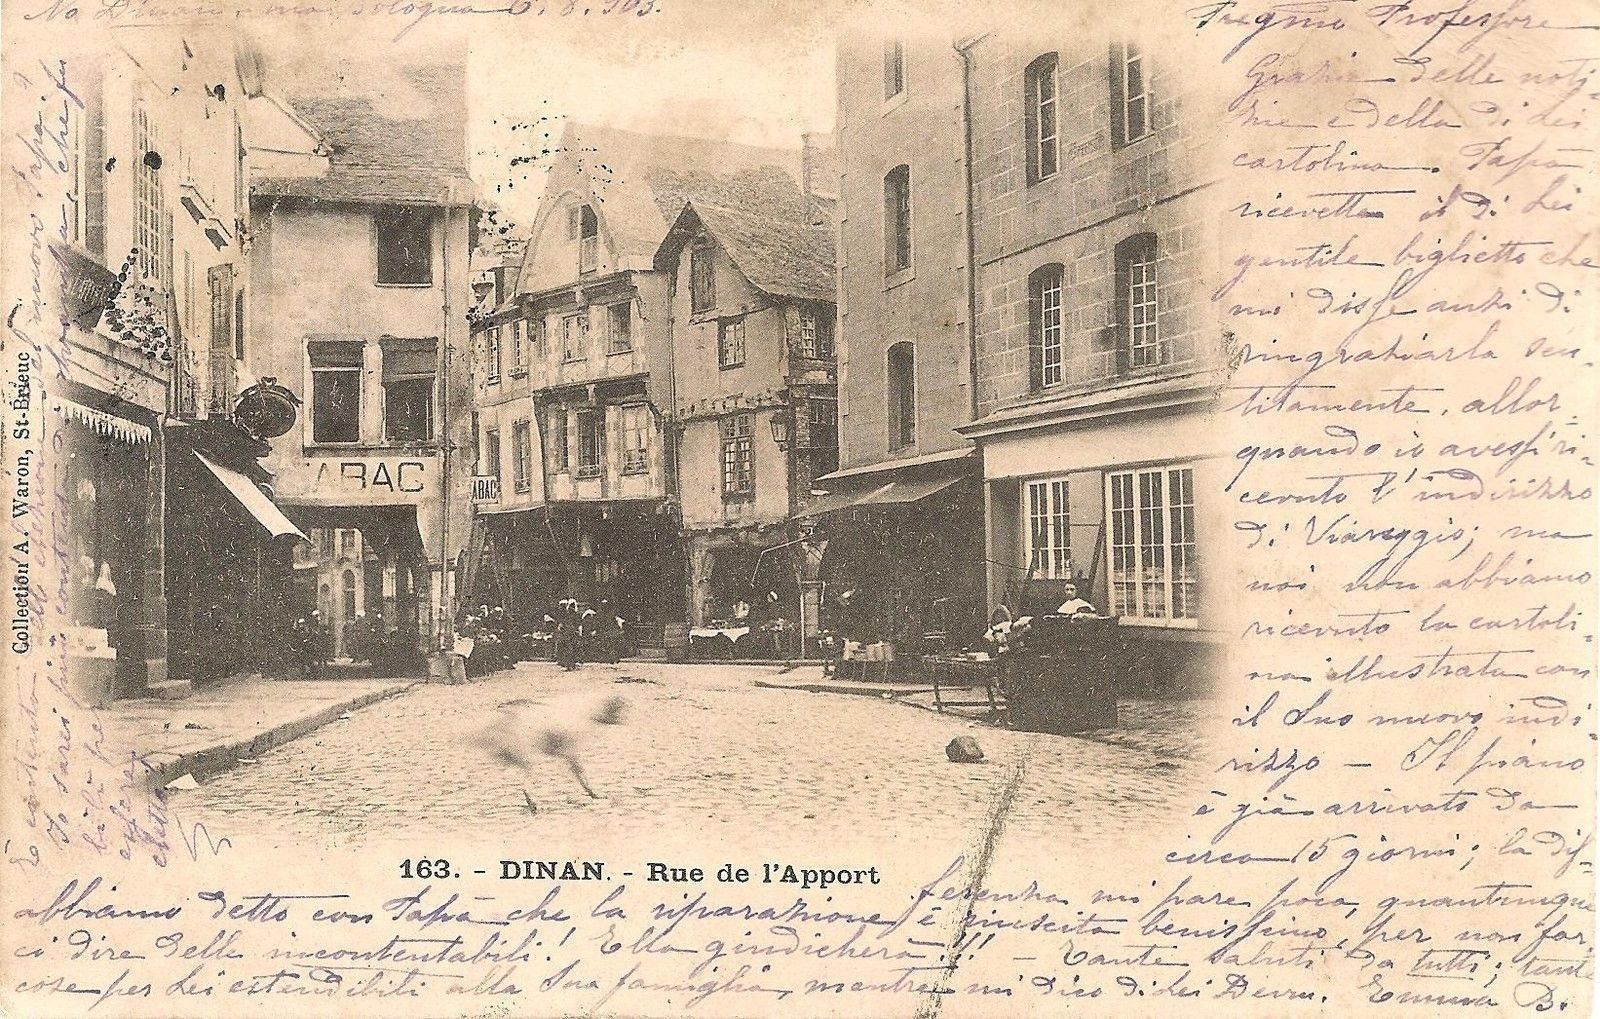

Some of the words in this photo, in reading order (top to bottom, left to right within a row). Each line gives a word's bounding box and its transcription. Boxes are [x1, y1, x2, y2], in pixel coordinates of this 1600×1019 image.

[1393, 55, 1504, 84] delle
[1346, 98, 1461, 129] della
[1521, 184, 1583, 215] Lei
[1211, 234, 1385, 301] gentile
[1393, 230, 1554, 270] biglietto
[1537, 234, 1600, 268] che
[1228, 290, 1294, 316] mi
[1426, 286, 1526, 313] anzi
[1535, 282, 1583, 314] di
[305, 461, 424, 493] ABAC
[1224, 425, 1382, 491] quando
[1234, 520, 1291, 549] di
[1500, 524, 1593, 541] ma
[1248, 564, 1316, 593] noi
[1344, 564, 1419, 592] non
[1433, 552, 1592, 591] abbiamo
[1241, 608, 1410, 639] ricevuto
[1419, 603, 1459, 632] la
[1249, 667, 1312, 683] na
[1324, 646, 1535, 684] illustrata
[1535, 662, 1591, 681] con
[1231, 690, 1280, 728] il
[1283, 689, 1354, 728] Suo
[1366, 711, 1484, 727] nuovo
[1215, 747, 1321, 792] rizzo
[1453, 736, 1587, 786] piano
[1211, 796, 1314, 844] già
[1323, 788, 1479, 816] arrivato
[1487, 788, 1579, 813] da
[1165, 834, 1290, 864] circa
[1288, 833, 1357, 865] 15
[1497, 826, 1533, 856] la
[14, 877, 182, 928] abbiamo
[198, 890, 349, 925] detto
[311, 907, 374, 926] con
[505, 884, 571, 922] che
[589, 884, 626, 920] la
[651, 890, 896, 930] riparazione
[1348, 911, 1432, 957] per
[1454, 929, 1522, 944] non
[1090, 878, 1156, 906] mi
[1142, 875, 1251, 919] pare
[1377, 881, 1597, 929] quantunque
[13, 934, 61, 959] ci
[68, 929, 146, 960] dire
[155, 929, 244, 961] delle
[589, 923, 698, 955] Ella
[1345, 946, 1395, 971] da
[14, 975, 101, 995] cose
[89, 968, 152, 1012] per
[165, 963, 226, 997] Lei
[445, 963, 523, 995] alla
[537, 958, 600, 993] Sua
[805, 965, 957, 996] mentre
[966, 974, 1024, 997] mi
[1032, 974, 1103, 997] dico
[1116, 975, 1157, 997] di
[1152, 968, 1213, 998] Lei
[1358, 972, 1500, 1007] Emma
[1513, 980, 1569, 1013] B.
